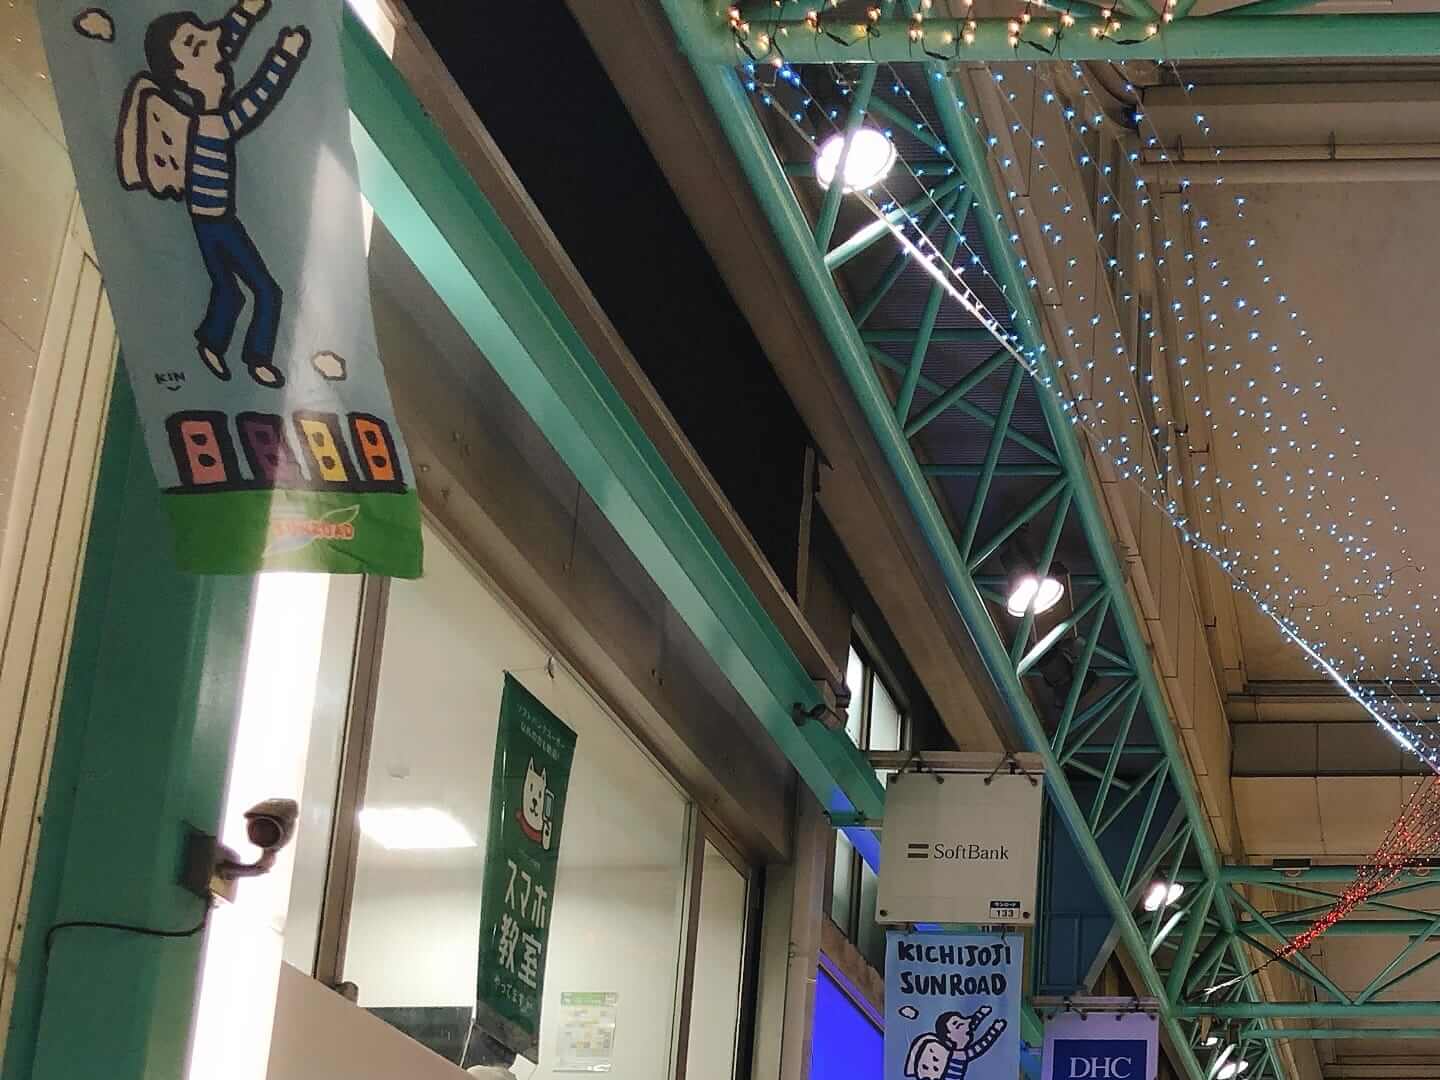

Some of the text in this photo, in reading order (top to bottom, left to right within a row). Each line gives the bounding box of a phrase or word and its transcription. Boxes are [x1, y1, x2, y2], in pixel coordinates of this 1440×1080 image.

[933, 843, 1009, 860] SoftBank
[504, 859, 548, 929] スマホ
[996, 909, 1014, 918] 133
[498, 912, 541, 989] 教室
[897, 940, 1011, 967] KICHIJOJI
[900, 971, 1008, 997] SUNROAD
[1069, 1056, 1132, 1079] DHC
